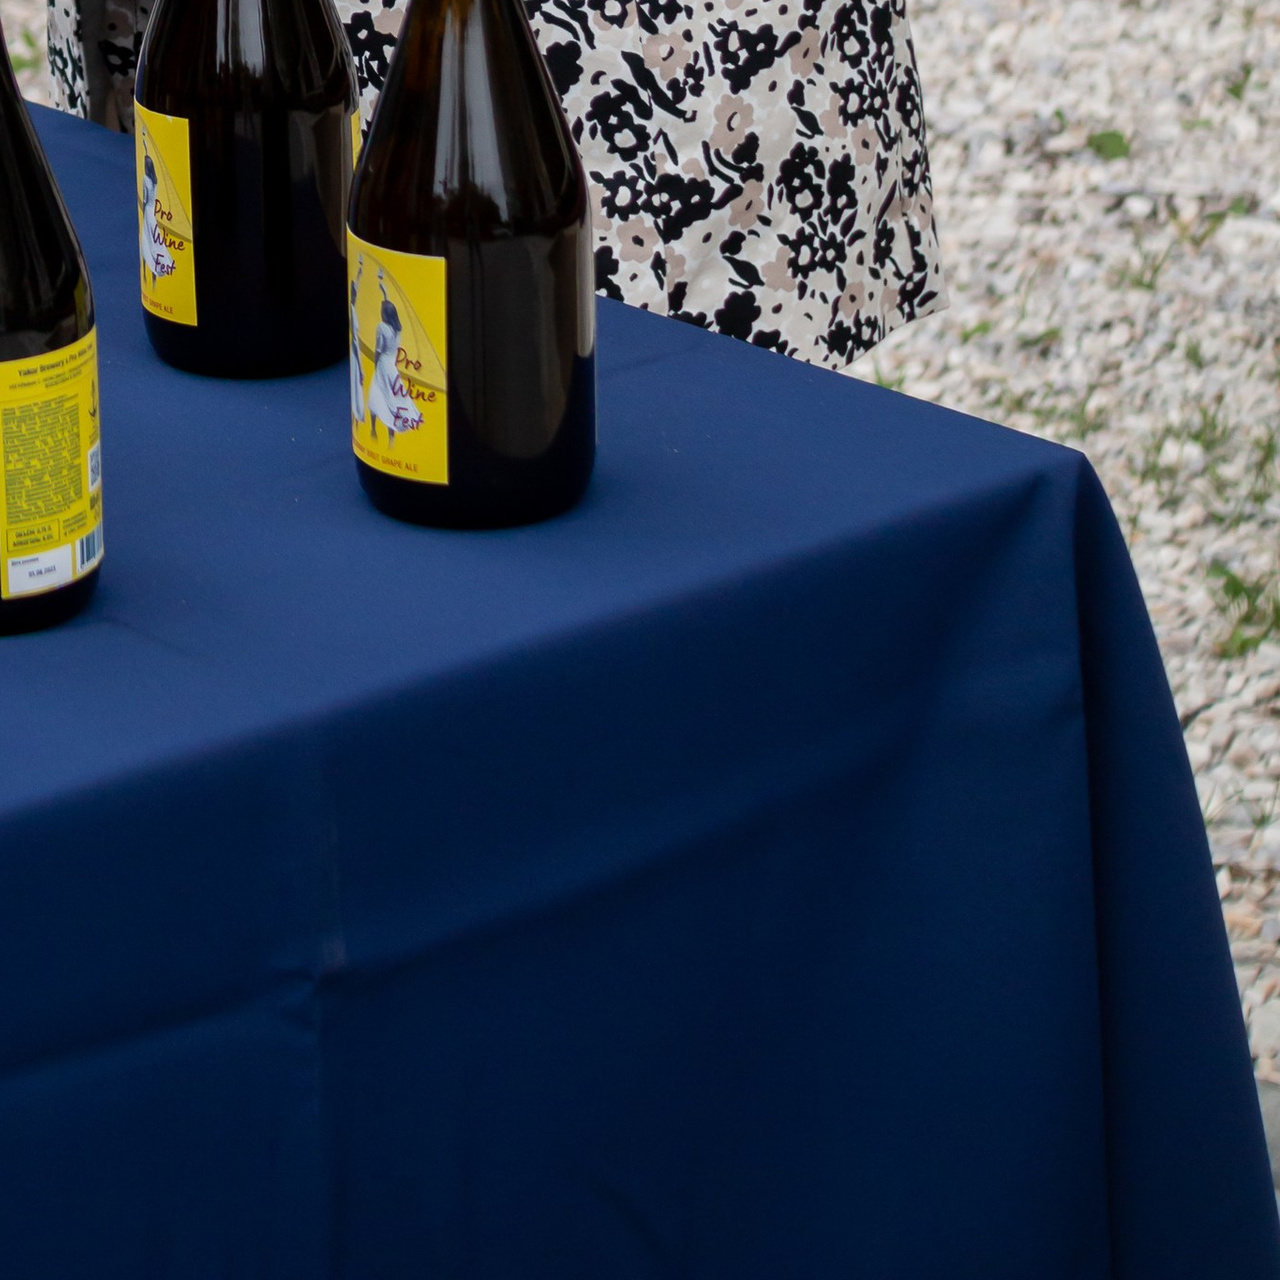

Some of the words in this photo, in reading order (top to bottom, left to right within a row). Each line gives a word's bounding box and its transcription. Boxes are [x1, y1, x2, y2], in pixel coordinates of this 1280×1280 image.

[154, 198, 173, 222] Pro
[152, 223, 186, 251] Wine
[154, 254, 176, 276] Fest
[395, 347, 422, 372] Pro
[391, 373, 437, 403] Wine
[393, 406, 424, 431] Fest
[381, 455, 403, 469] GRAPE
[405, 462, 418, 472] ALE
